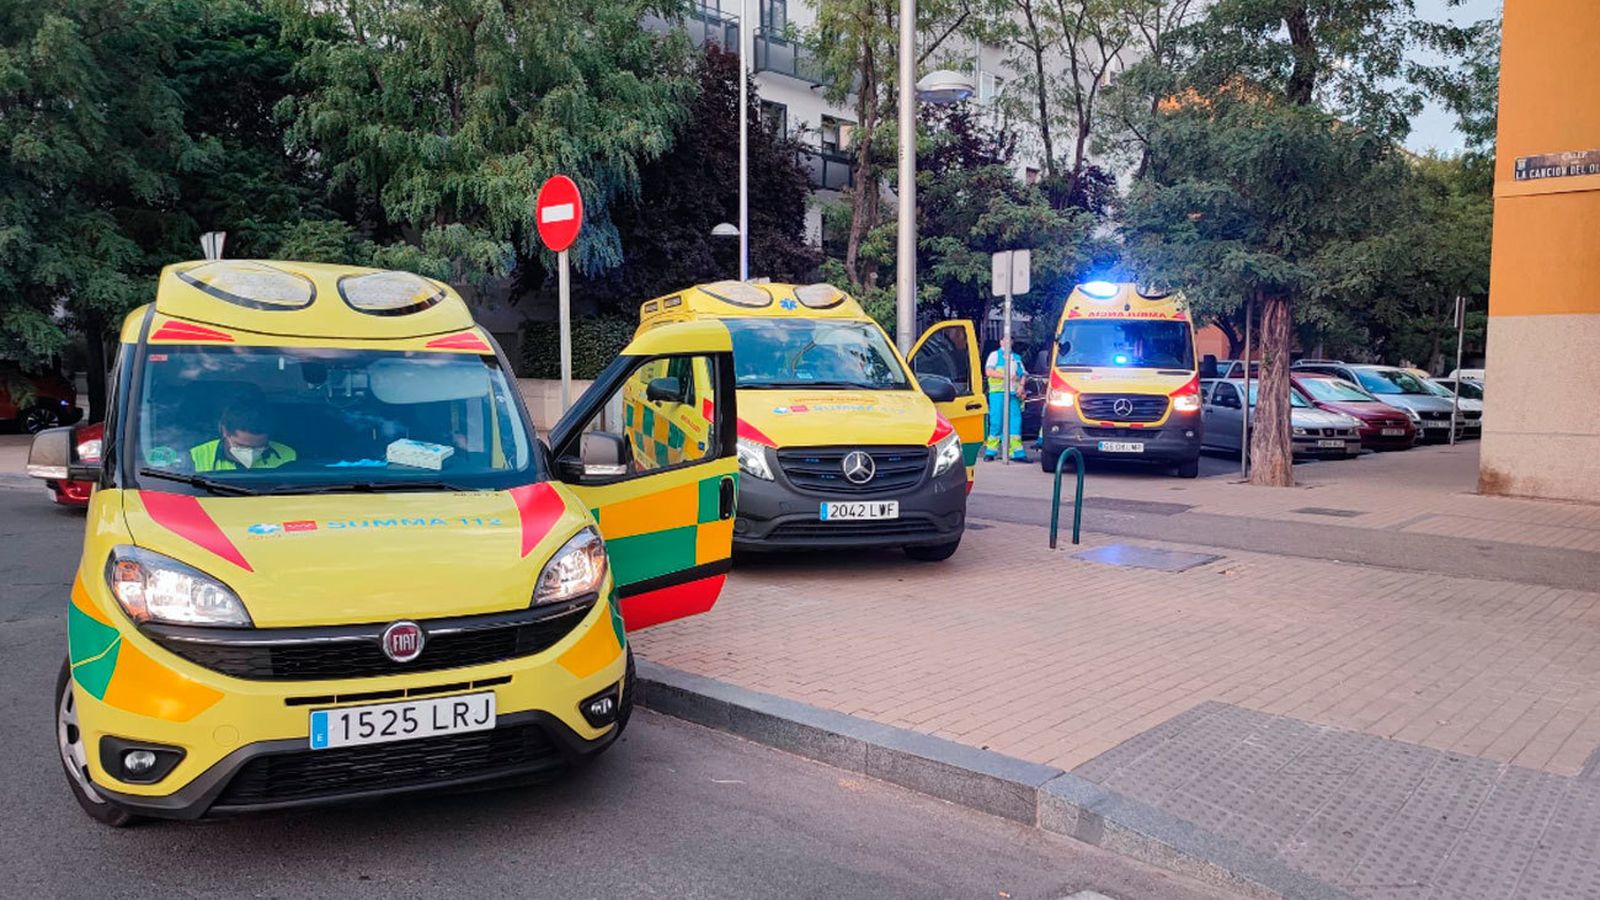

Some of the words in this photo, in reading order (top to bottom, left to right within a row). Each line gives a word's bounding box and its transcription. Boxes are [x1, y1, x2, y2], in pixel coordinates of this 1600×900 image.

[1516, 171, 1527, 179] LA
[830, 504, 866, 518] 2042
[327, 518, 447, 529] SUMMA
[458, 517, 503, 526] 112
[392, 633, 417, 652] FIAT
[341, 706, 418, 740] 1525
[432, 699, 490, 730] LRJ
